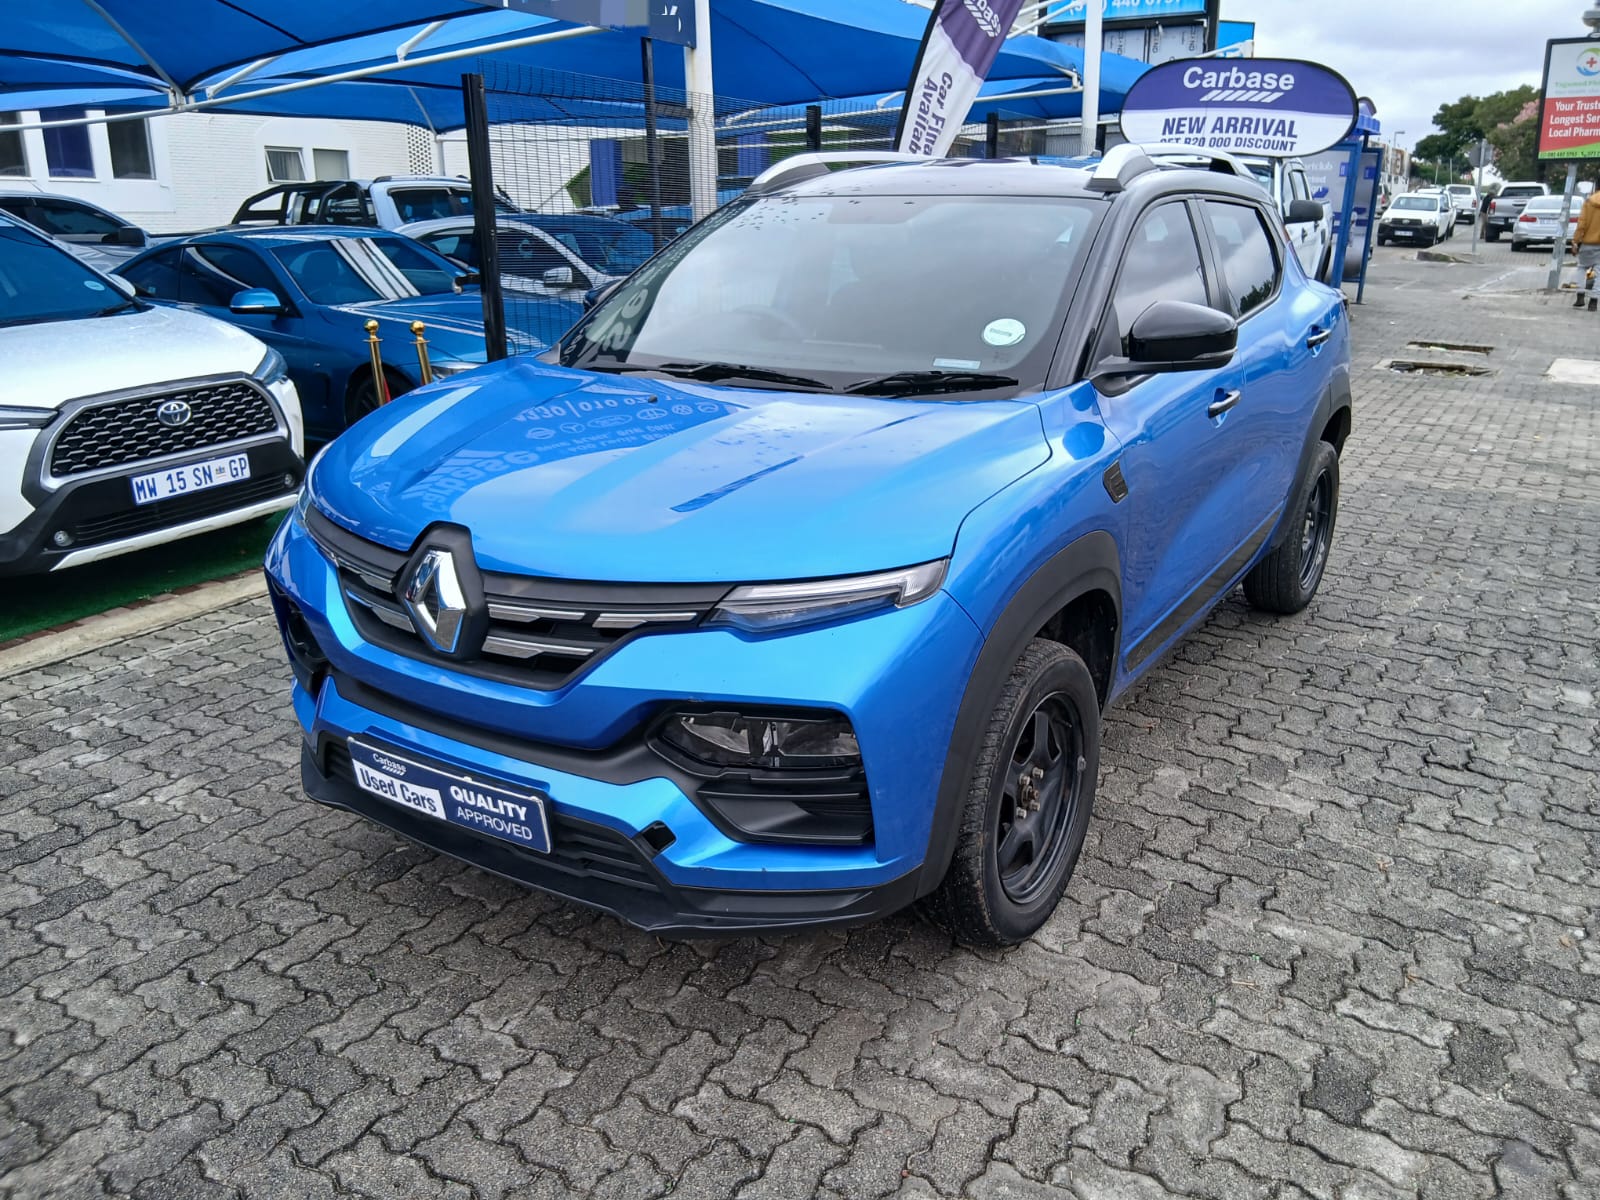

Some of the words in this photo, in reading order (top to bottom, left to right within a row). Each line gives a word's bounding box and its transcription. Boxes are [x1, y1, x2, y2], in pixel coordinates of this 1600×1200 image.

[1183, 66, 1295, 90] Carbase
[937, 72, 953, 109] Car
[1556, 100, 1575, 111] Your
[1162, 117, 1207, 136] NEW
[1210, 117, 1298, 138] ARRIVAL
[1550, 114, 1584, 126] Longest
[923, 113, 946, 156] Fina
[1184, 137, 1206, 147] R20
[1209, 137, 1231, 148] 000
[1234, 137, 1297, 152] DISCOUNT
[1549, 127, 1571, 138] Local
[135, 477, 157, 501] MW
[166, 471, 187, 494] 15
[194, 465, 213, 487] SN
[229, 457, 247, 478] GP
[372, 752, 407, 773] Carbase
[360, 767, 397, 799] Used
[400, 784, 438, 813] Cars
[450, 785, 527, 821] QUALITY
[457, 806, 533, 840] APPROVED
